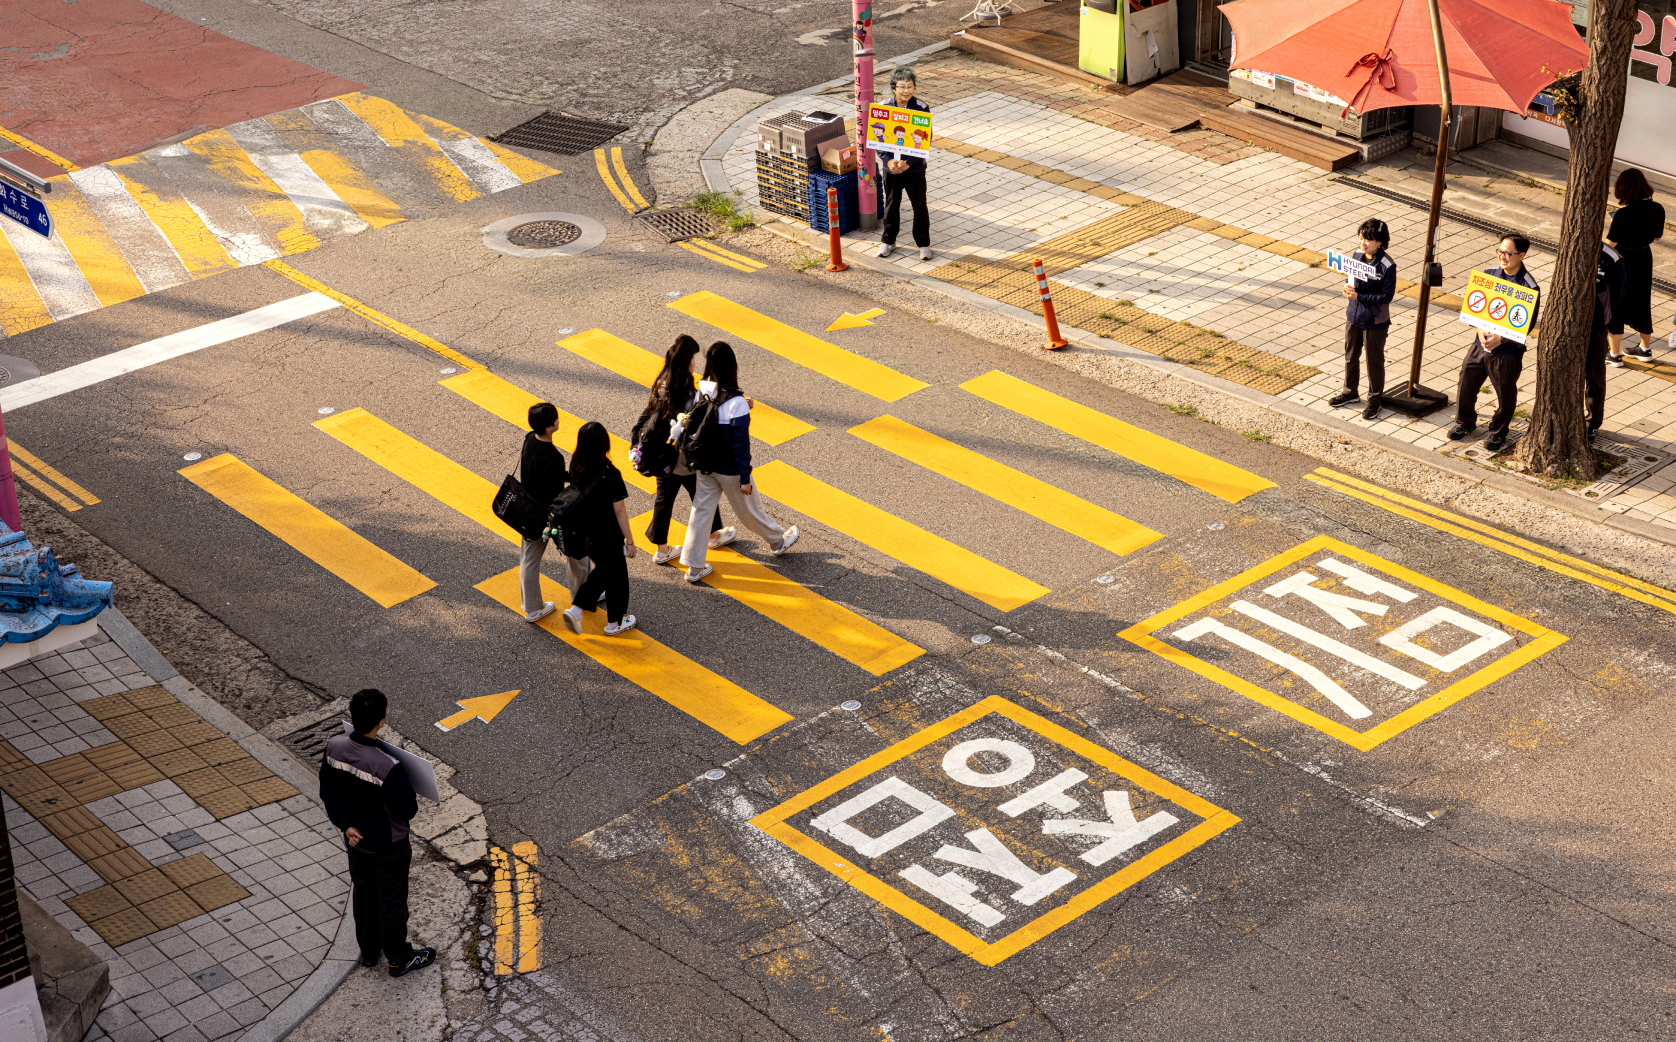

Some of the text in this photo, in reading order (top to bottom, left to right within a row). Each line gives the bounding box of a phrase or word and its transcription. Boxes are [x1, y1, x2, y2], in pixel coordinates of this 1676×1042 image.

[872, 109, 889, 118] 멈추고
[892, 113, 909, 122] 살피고
[913, 116, 929, 125] 건너요
[38, 212, 48, 227] 46
[1343, 257, 1375, 275] HYUNDAI
[1343, 265, 1366, 280] STEEL
[1471, 275, 1535, 304] 차조심! 좌우를 살펴요
